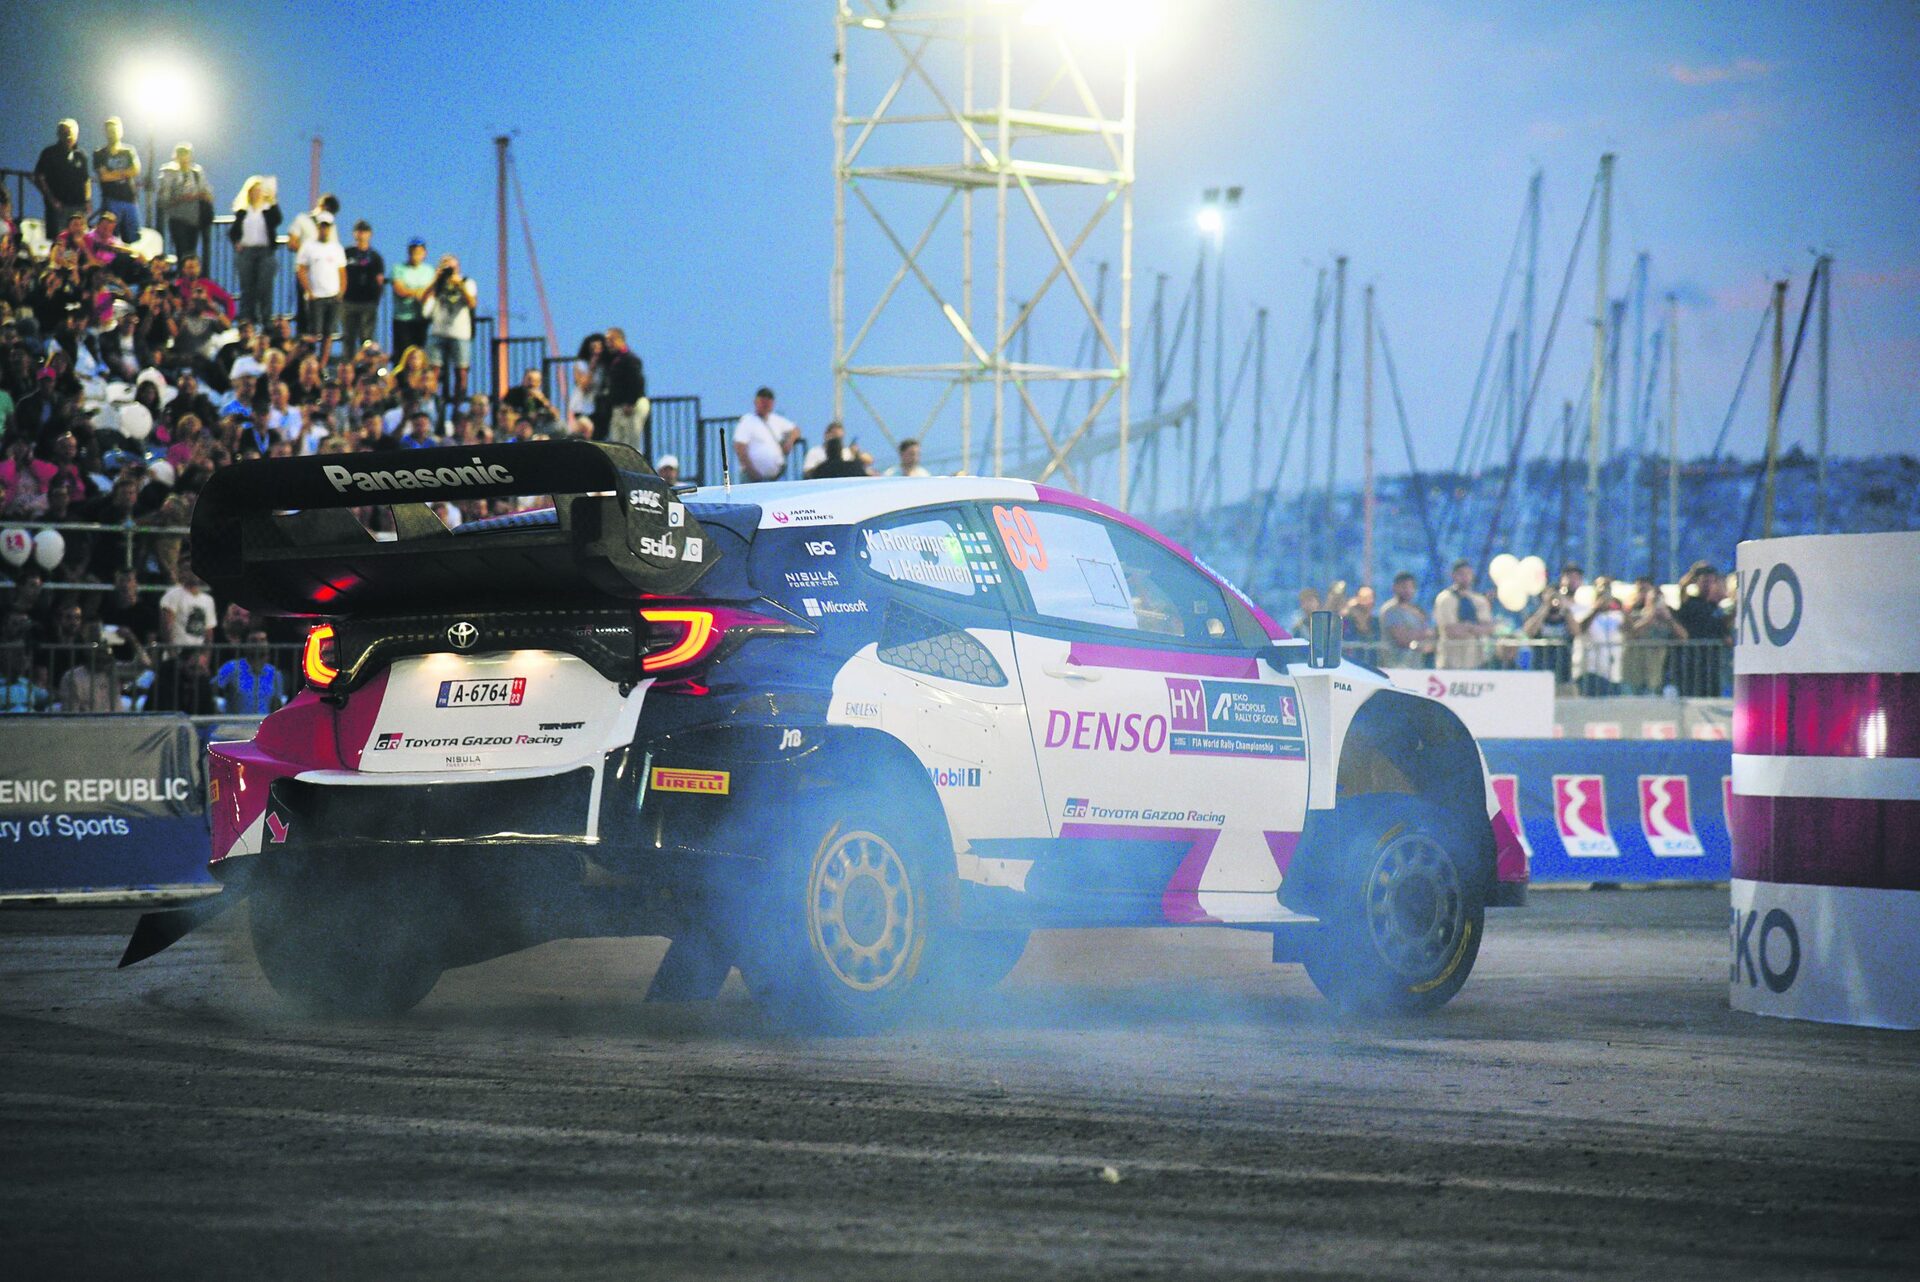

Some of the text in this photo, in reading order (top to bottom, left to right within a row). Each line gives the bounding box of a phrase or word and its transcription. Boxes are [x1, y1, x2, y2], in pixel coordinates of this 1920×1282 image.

[322, 457, 515, 493] Panasonic
[992, 505, 1049, 572] 69
[784, 571, 837, 582] NISULA
[820, 599, 869, 613] Microsoft
[1736, 562, 1803, 648] KO
[453, 683, 508, 703] A-6764
[514, 680, 523, 690] 11
[1333, 682, 1352, 692] PIAA
[511, 693, 521, 704] 23
[1170, 688, 1200, 719] HY
[1234, 703, 1266, 713] ACROPOLIS
[1235, 712, 1251, 721] RALLY
[1253, 714, 1260, 723] OF
[405, 738, 459, 748] TOYOTA
[462, 736, 513, 746] GAZOO
[515, 734, 564, 746] Racing
[1044, 709, 1168, 754] DENSO
[1192, 738, 1202, 747] FIA
[1203, 738, 1220, 748] World
[1221, 739, 1235, 751] Rally
[1235, 740, 1274, 753] Championship
[445, 755, 481, 763] NISULA
[64, 778, 189, 802] REPUBLIC
[656, 771, 724, 790] PIRELLI
[1063, 804, 1226, 826] GR TOYOTA GAZOO Racing
[28, 815, 51, 837] of
[56, 814, 131, 840] Sports
[1729, 907, 1801, 994] KO
